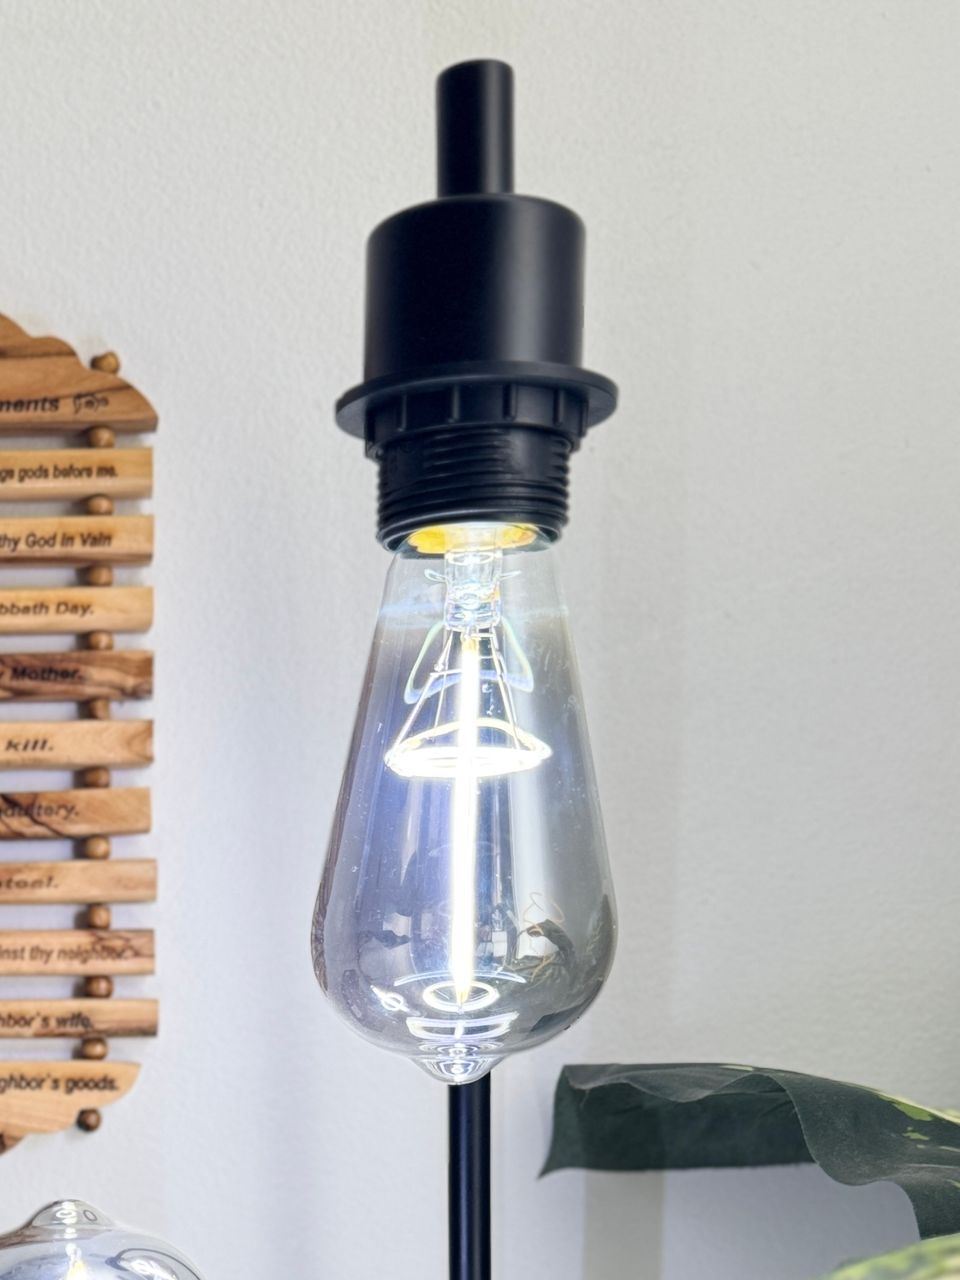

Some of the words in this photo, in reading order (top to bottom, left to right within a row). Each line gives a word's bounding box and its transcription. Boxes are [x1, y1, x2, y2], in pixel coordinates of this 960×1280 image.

[18, 465, 49, 482] gods
[53, 465, 93, 478] before
[25, 532, 57, 549] God
[5, 739, 54, 752] kill.
[65, 1074, 119, 1094] goods.
